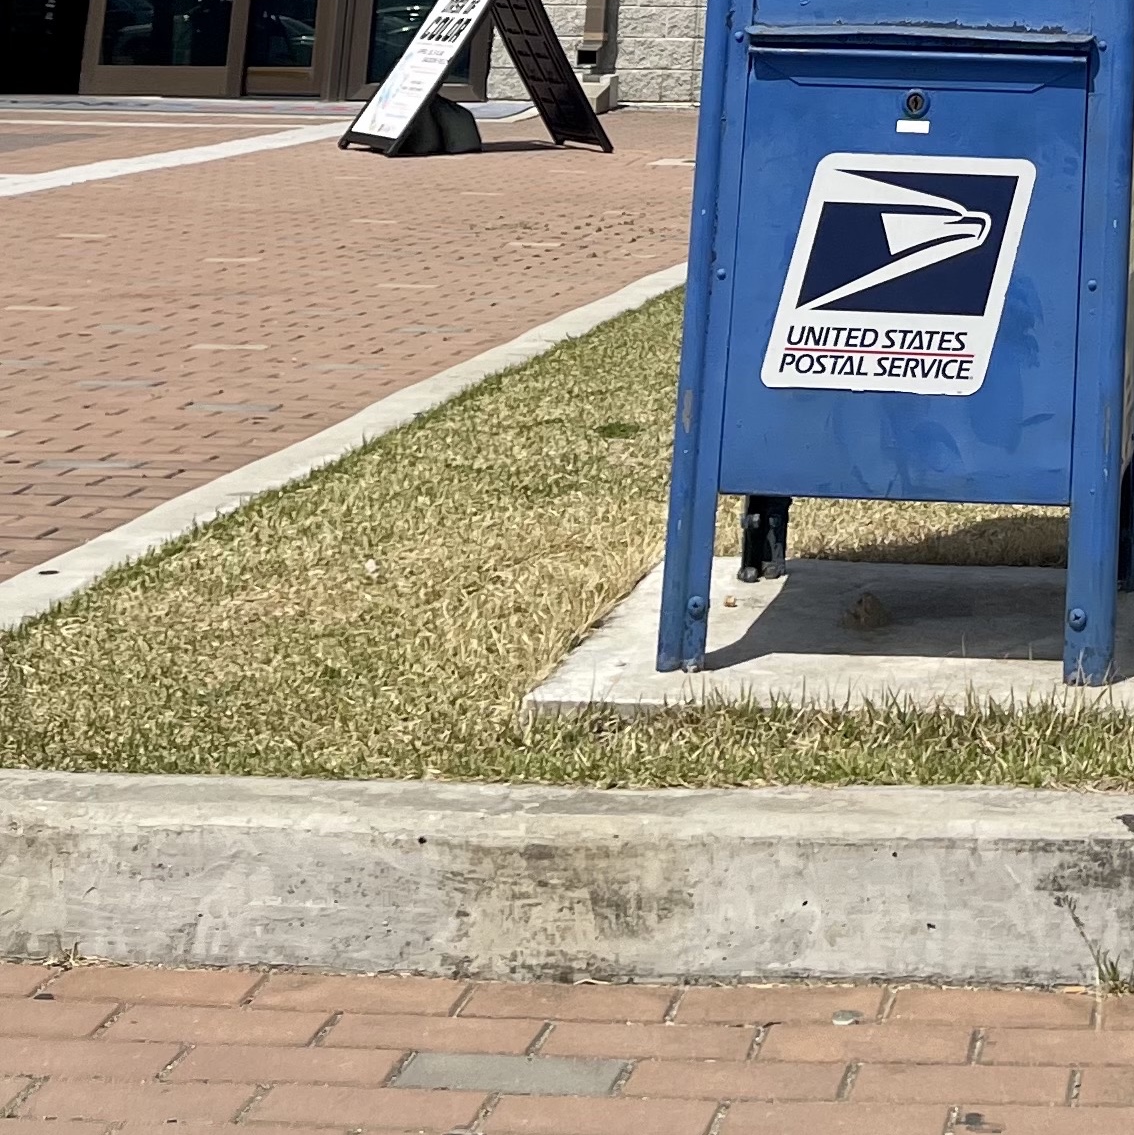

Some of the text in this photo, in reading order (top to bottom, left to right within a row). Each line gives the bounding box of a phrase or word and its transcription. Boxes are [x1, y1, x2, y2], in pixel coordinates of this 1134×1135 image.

[420, 16, 472, 43] COLOR
[786, 325, 968, 352] UNITED STATES
[779, 352, 974, 380] POSTAL SERVICE
